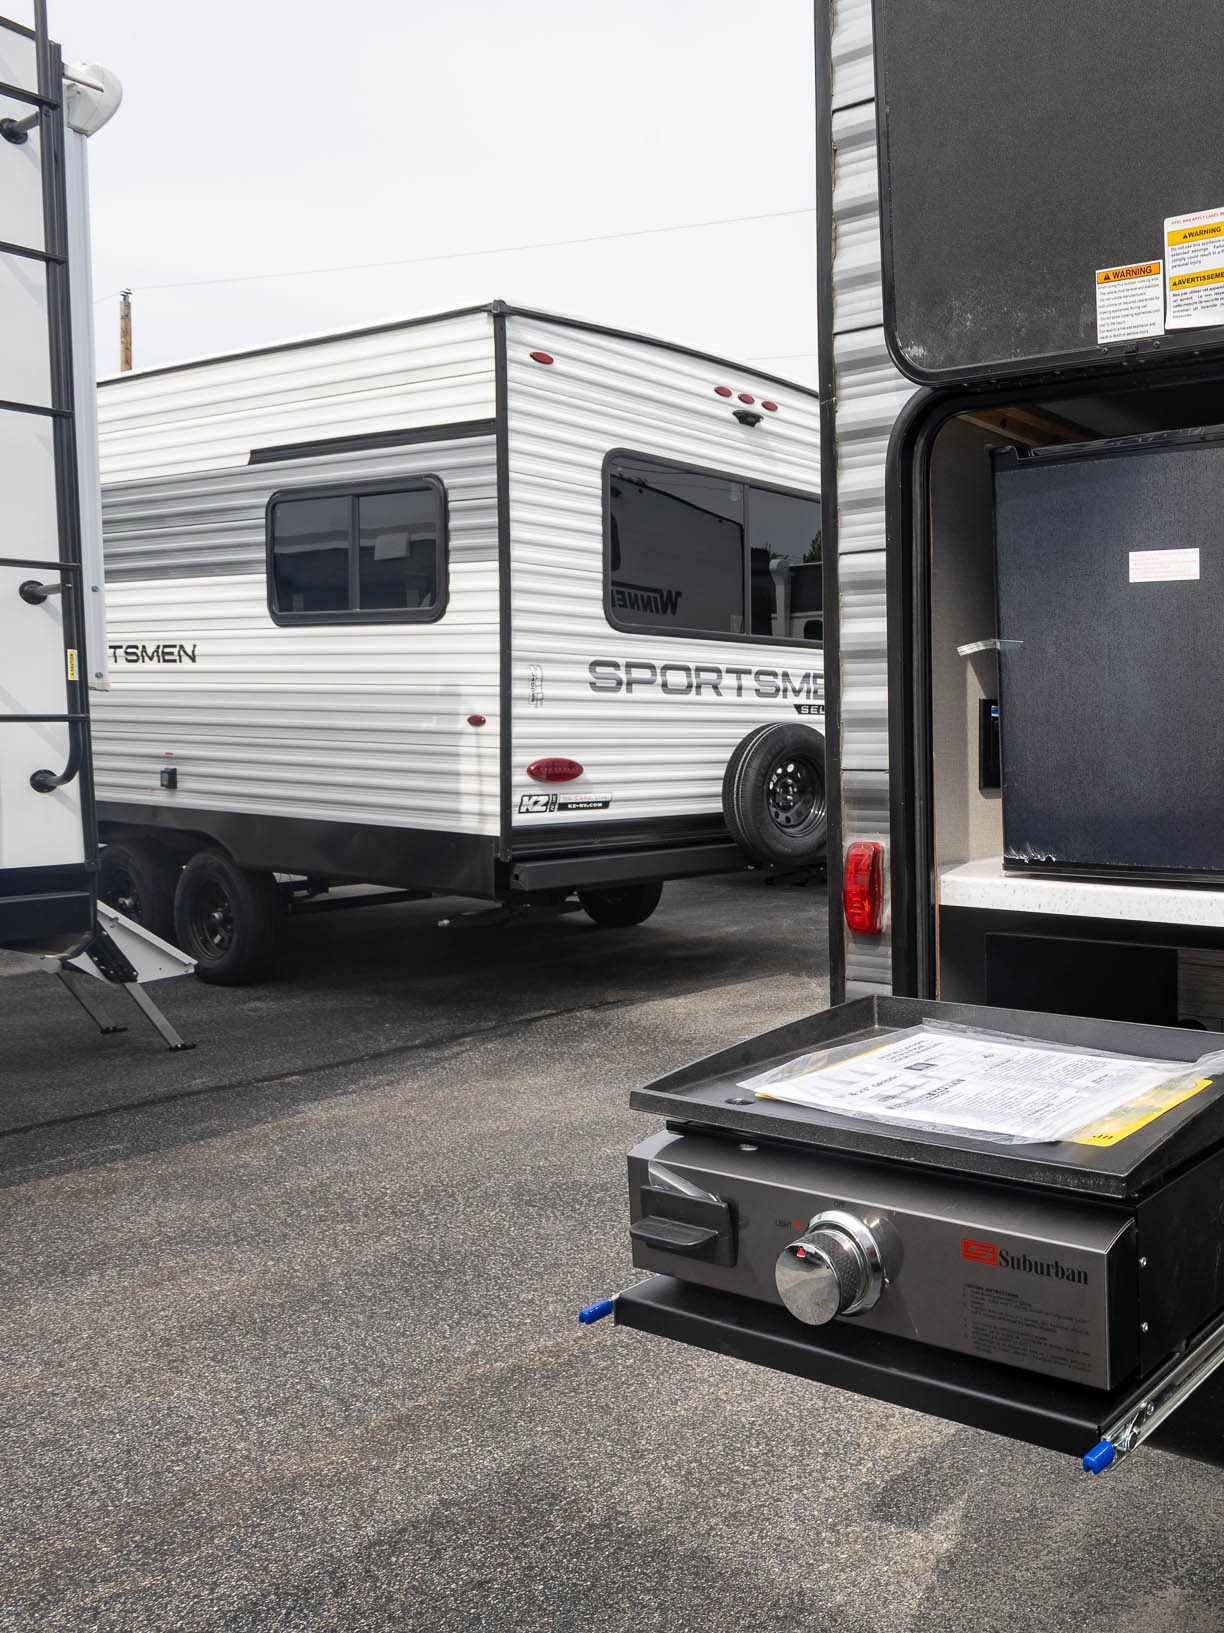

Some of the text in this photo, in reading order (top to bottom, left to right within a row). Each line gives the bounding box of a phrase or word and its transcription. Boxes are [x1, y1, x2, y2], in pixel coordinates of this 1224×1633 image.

[1188, 227, 1221, 237] WARNING
[1112, 266, 1152, 279] WARNING
[519, 795, 549, 813] KZ
[999, 1250, 1088, 1285] Suburban
